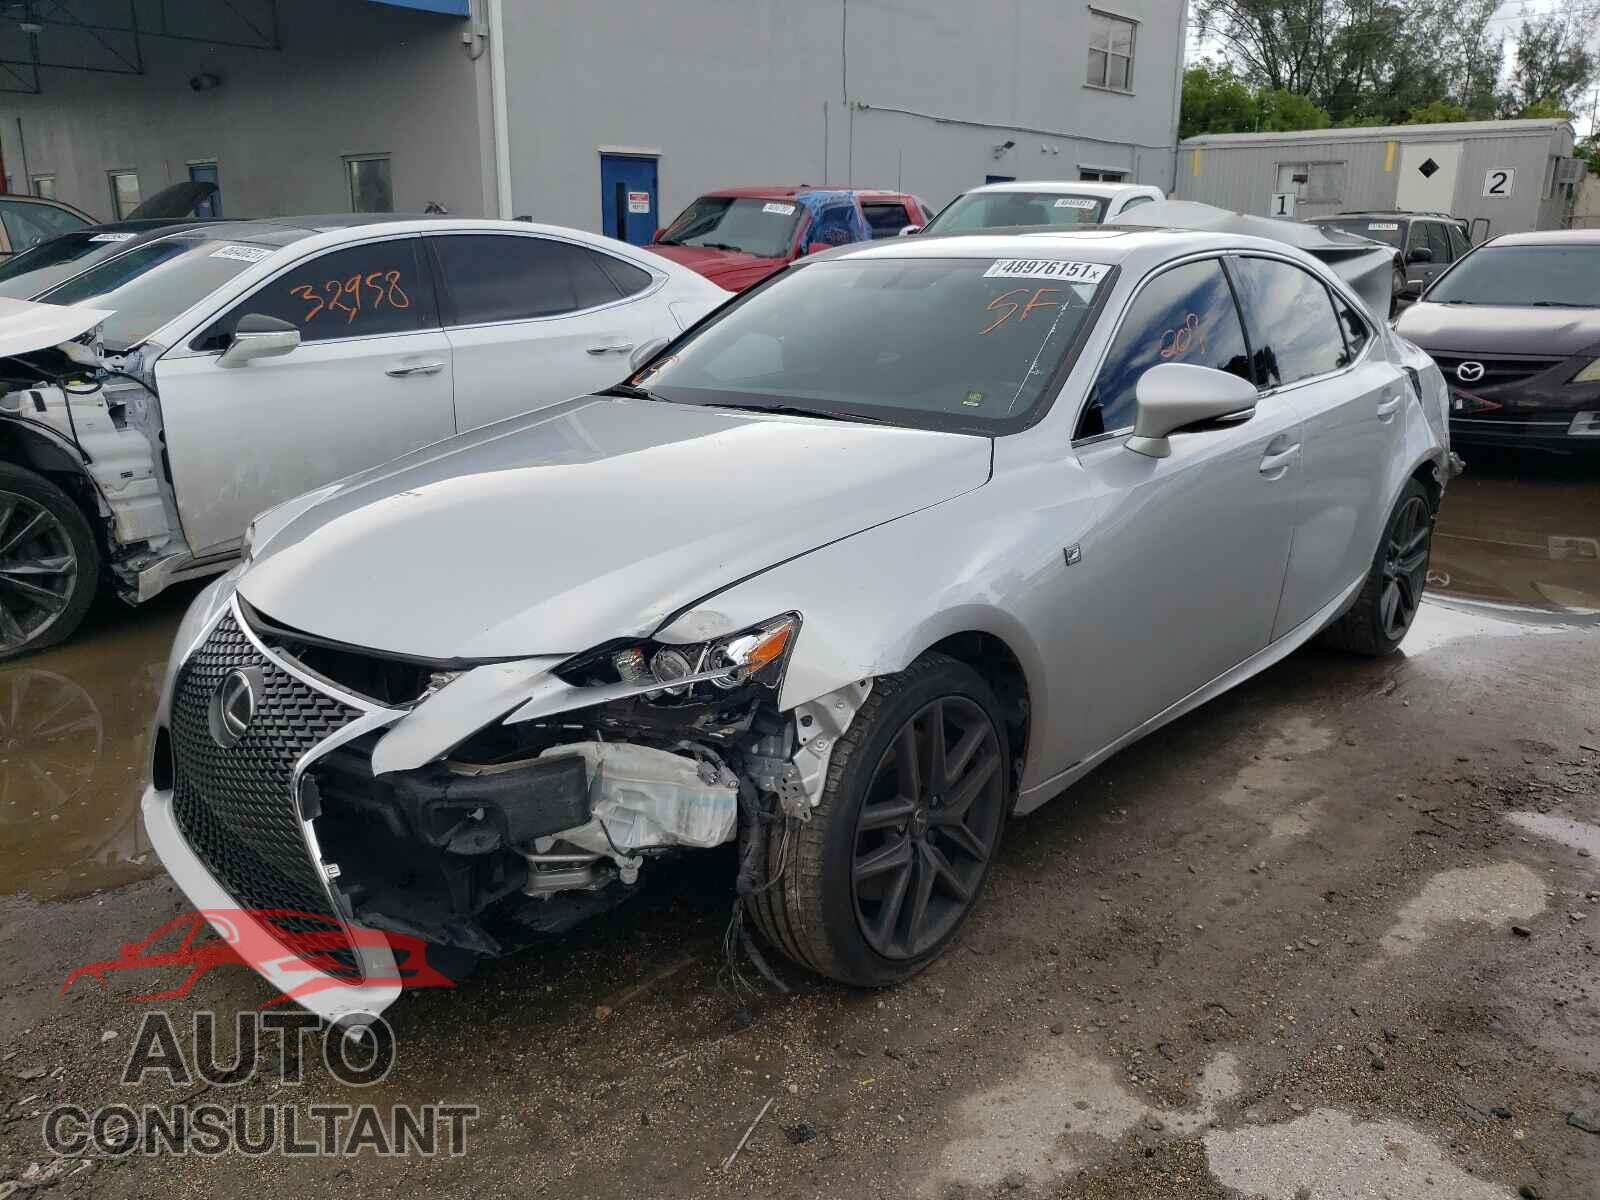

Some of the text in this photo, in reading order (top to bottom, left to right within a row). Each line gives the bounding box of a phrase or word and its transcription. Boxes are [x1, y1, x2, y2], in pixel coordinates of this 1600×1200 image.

[1489, 172, 1507, 193] 2
[1277, 195, 1287, 215] 1
[1002, 260, 1092, 278] 48976151
